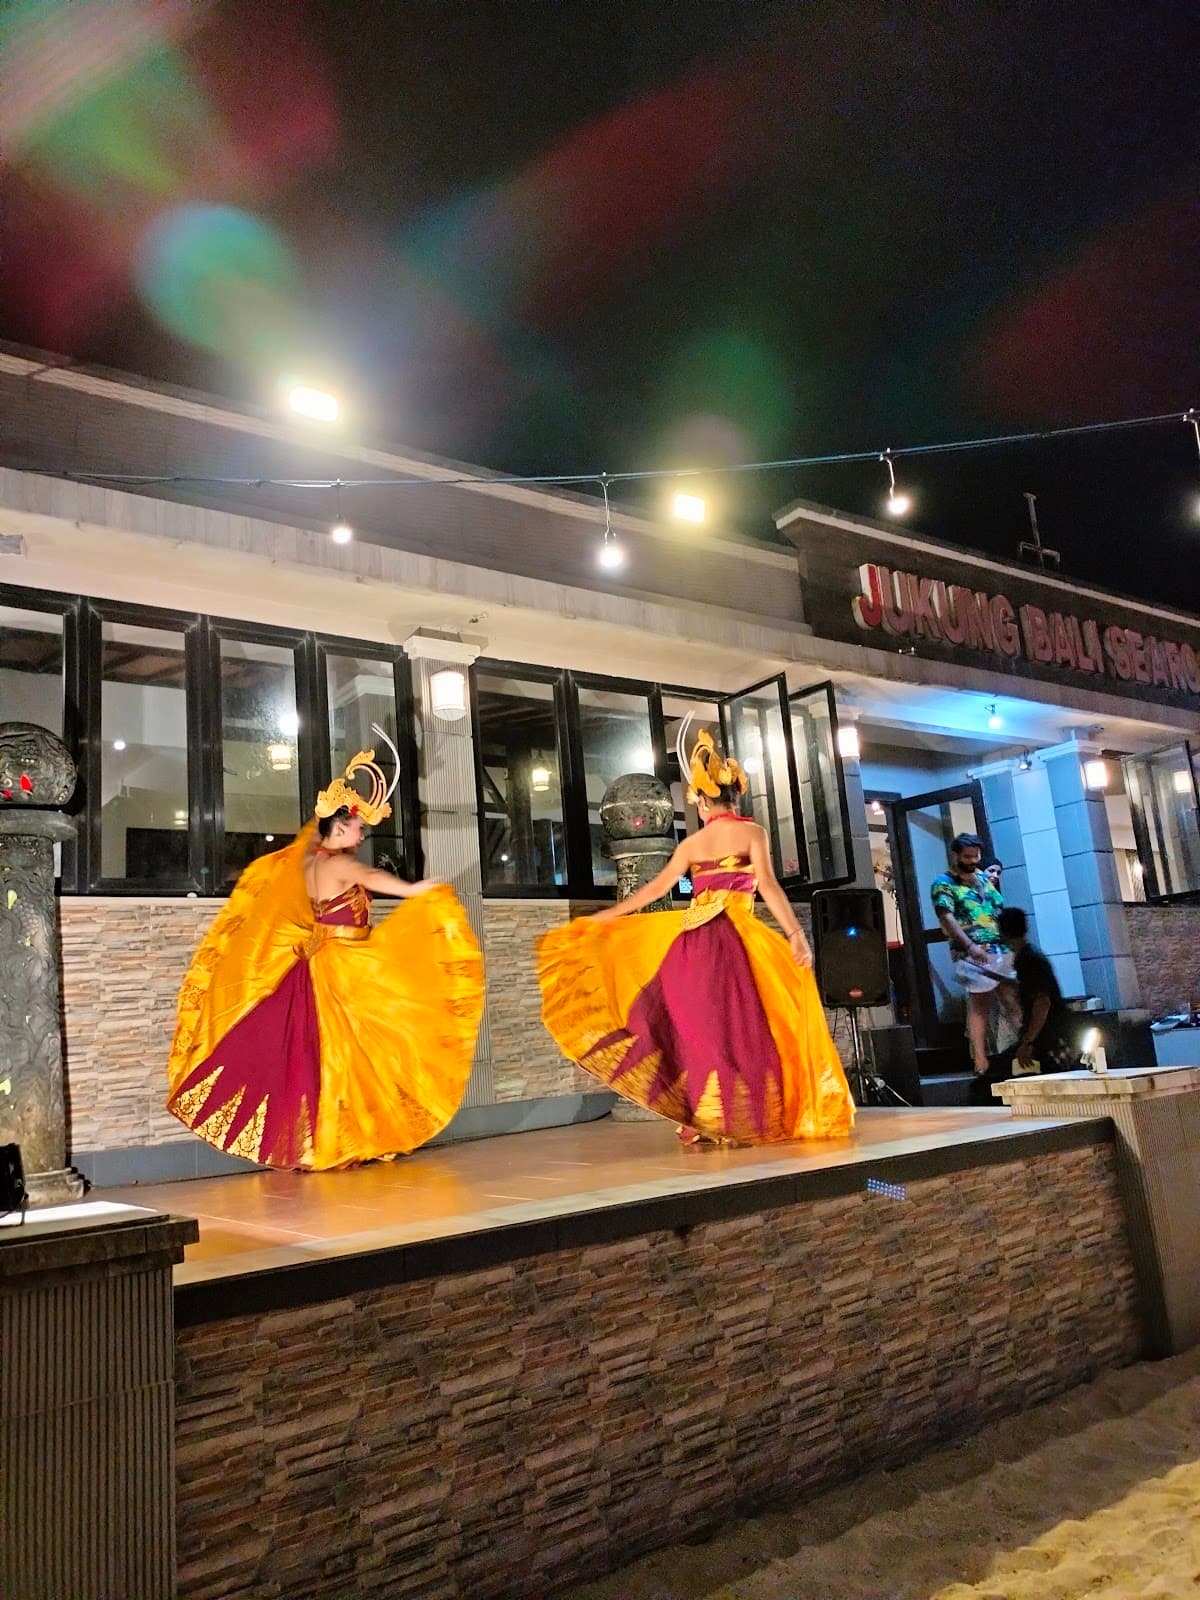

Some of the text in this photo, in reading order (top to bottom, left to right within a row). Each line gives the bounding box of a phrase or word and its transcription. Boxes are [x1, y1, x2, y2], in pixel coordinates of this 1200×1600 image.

[852, 563, 1200, 693] JUKUNG BALI SEAFO
